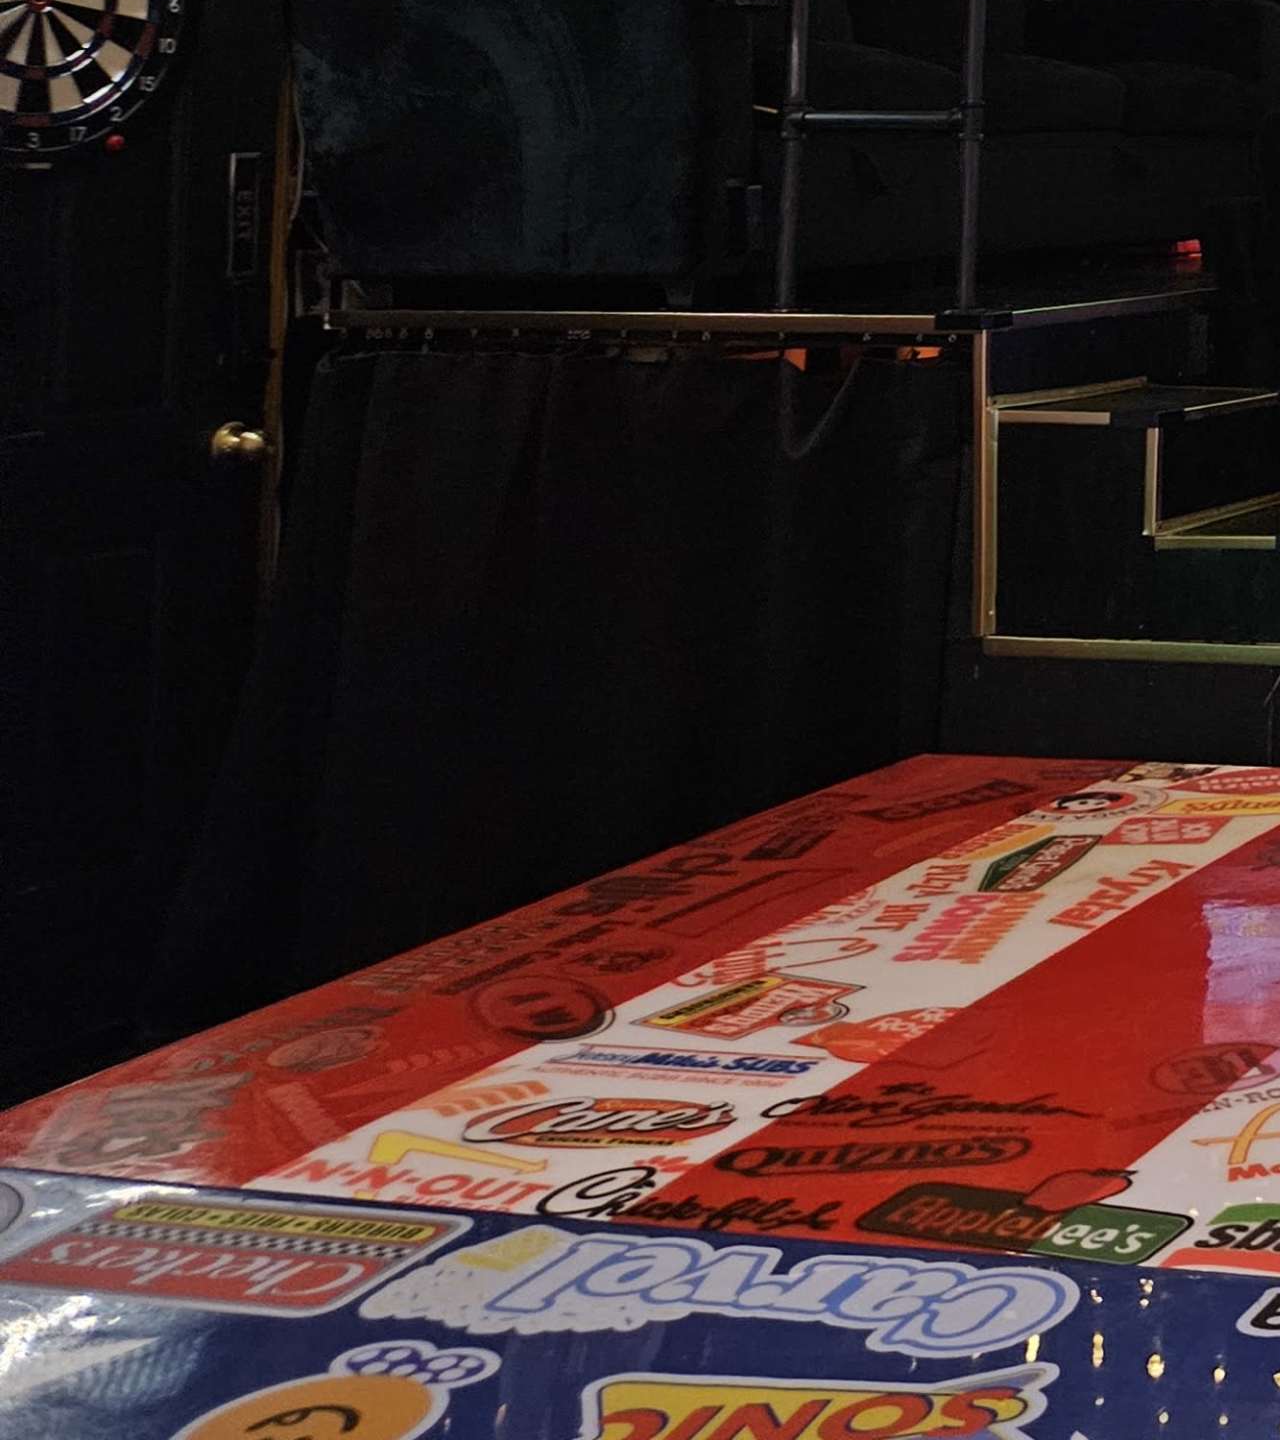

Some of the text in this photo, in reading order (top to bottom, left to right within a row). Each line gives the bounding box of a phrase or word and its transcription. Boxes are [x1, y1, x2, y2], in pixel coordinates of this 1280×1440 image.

[159, 38, 176, 54] 10
[110, 107, 123, 122] 2
[27, 132, 40, 148] 3
[69, 126, 87, 142] 17
[1048, 859, 1197, 930] Krystal
[722, 1055, 820, 1076] SUBS
[463, 1096, 739, 1144] Cane's
[885, 1194, 1158, 1255] Applebee's
[35, 1238, 366, 1297] Checkers
[487, 1238, 1067, 1352] Carvel
